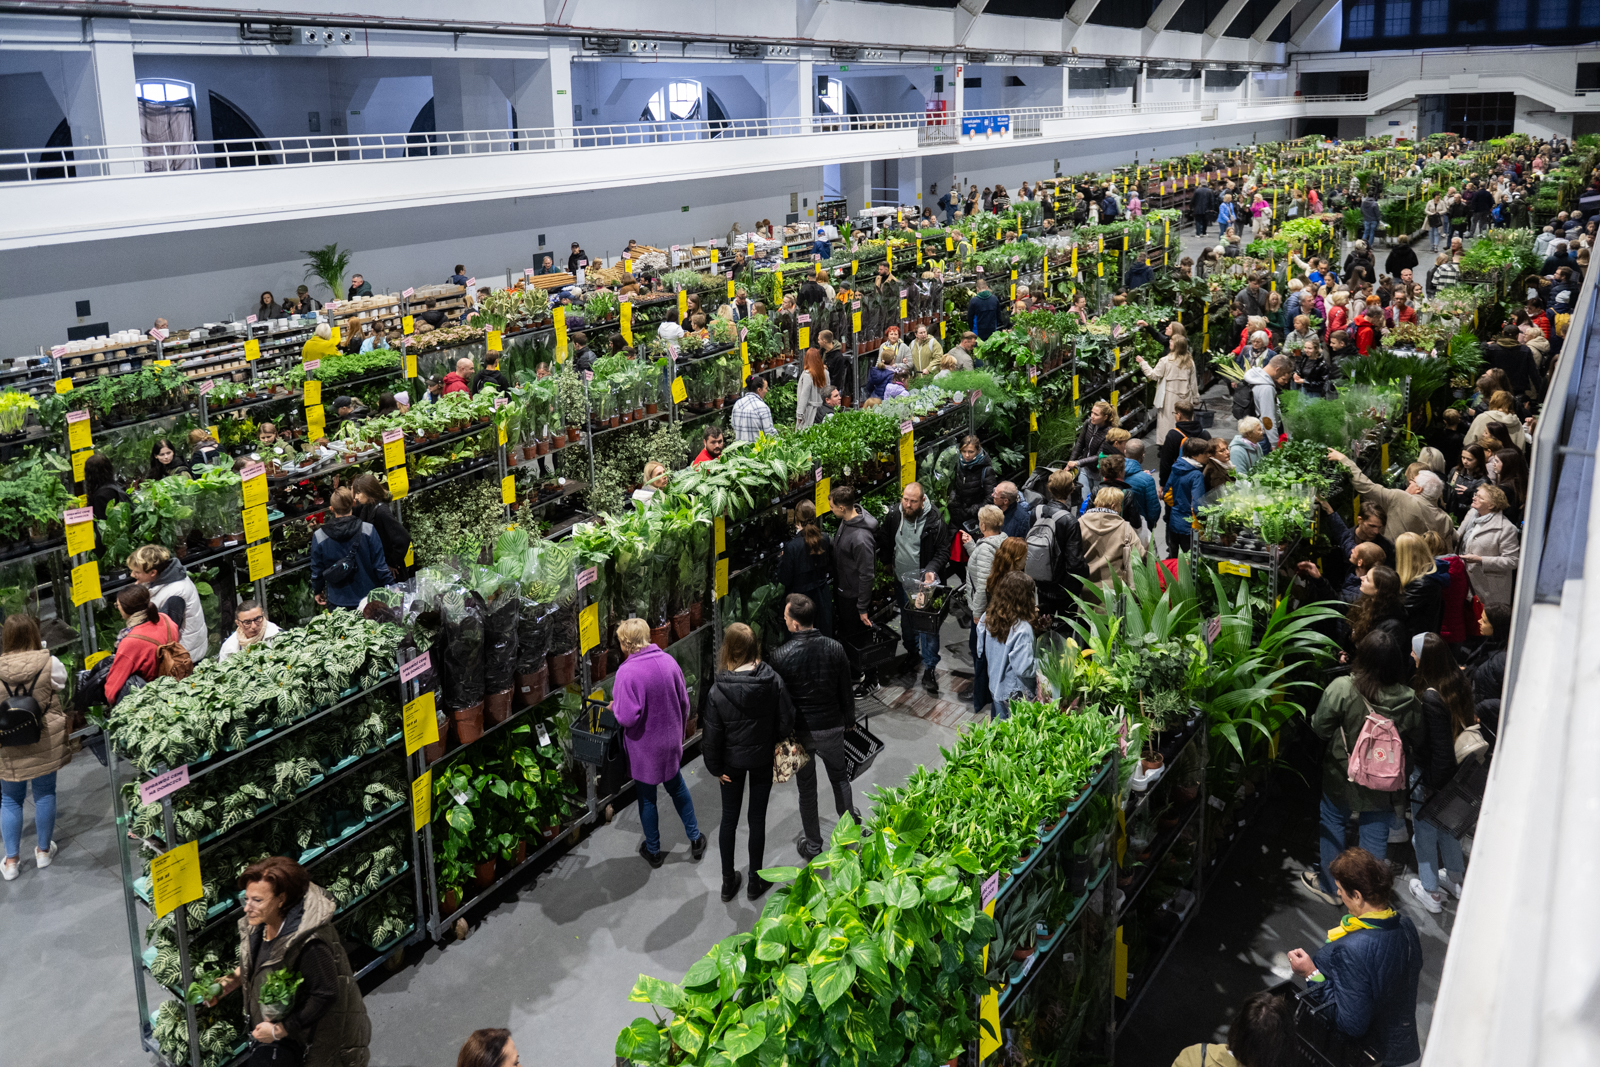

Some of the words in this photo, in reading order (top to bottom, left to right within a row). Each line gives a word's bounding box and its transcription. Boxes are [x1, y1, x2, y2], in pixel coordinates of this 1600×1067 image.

[145, 776, 170, 791] SPRAWDŹ
[170, 770, 183, 779] CENĘ
[157, 778, 182, 791] DONICZCE
